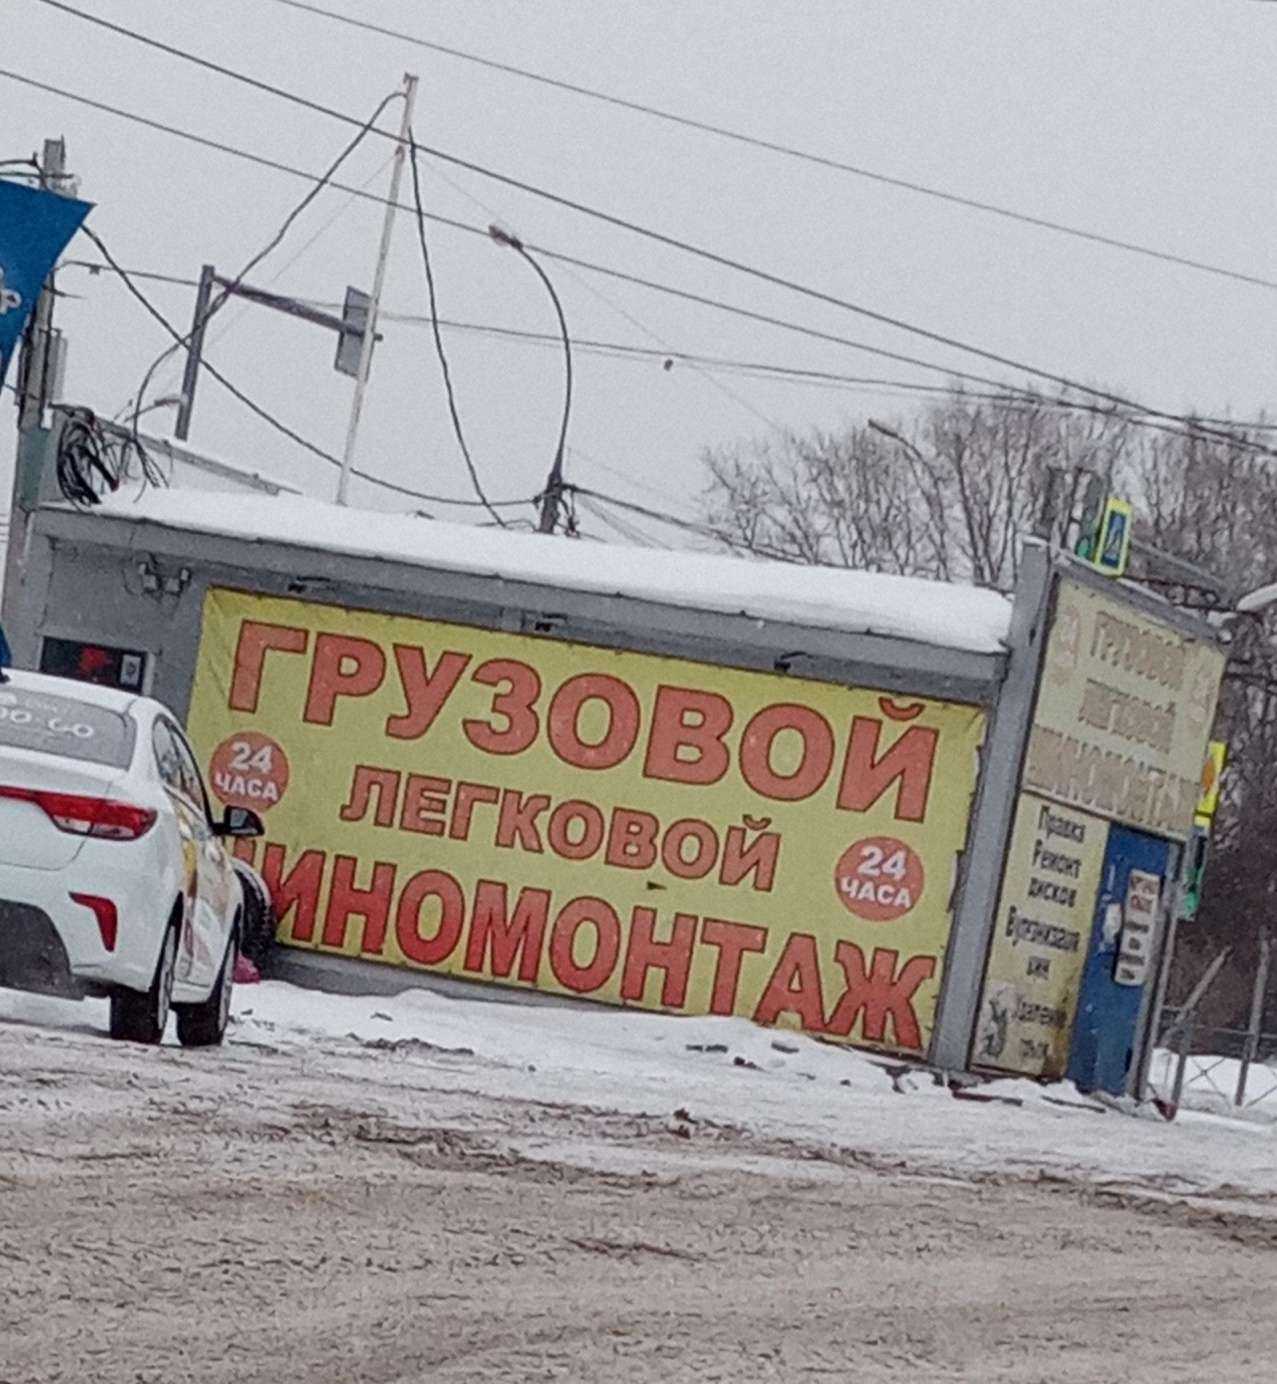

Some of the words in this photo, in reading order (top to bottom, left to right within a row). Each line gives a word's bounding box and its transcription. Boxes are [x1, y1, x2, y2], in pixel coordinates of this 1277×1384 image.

[228, 619, 940, 824] ГРУЗОВОЙ
[230, 742, 274, 775] 24
[214, 773, 279, 801] ЧАСА
[340, 764, 781, 892] ЛЕГКОВОЙ
[856, 845, 907, 881] 24
[840, 876, 912, 909] ЧАСА
